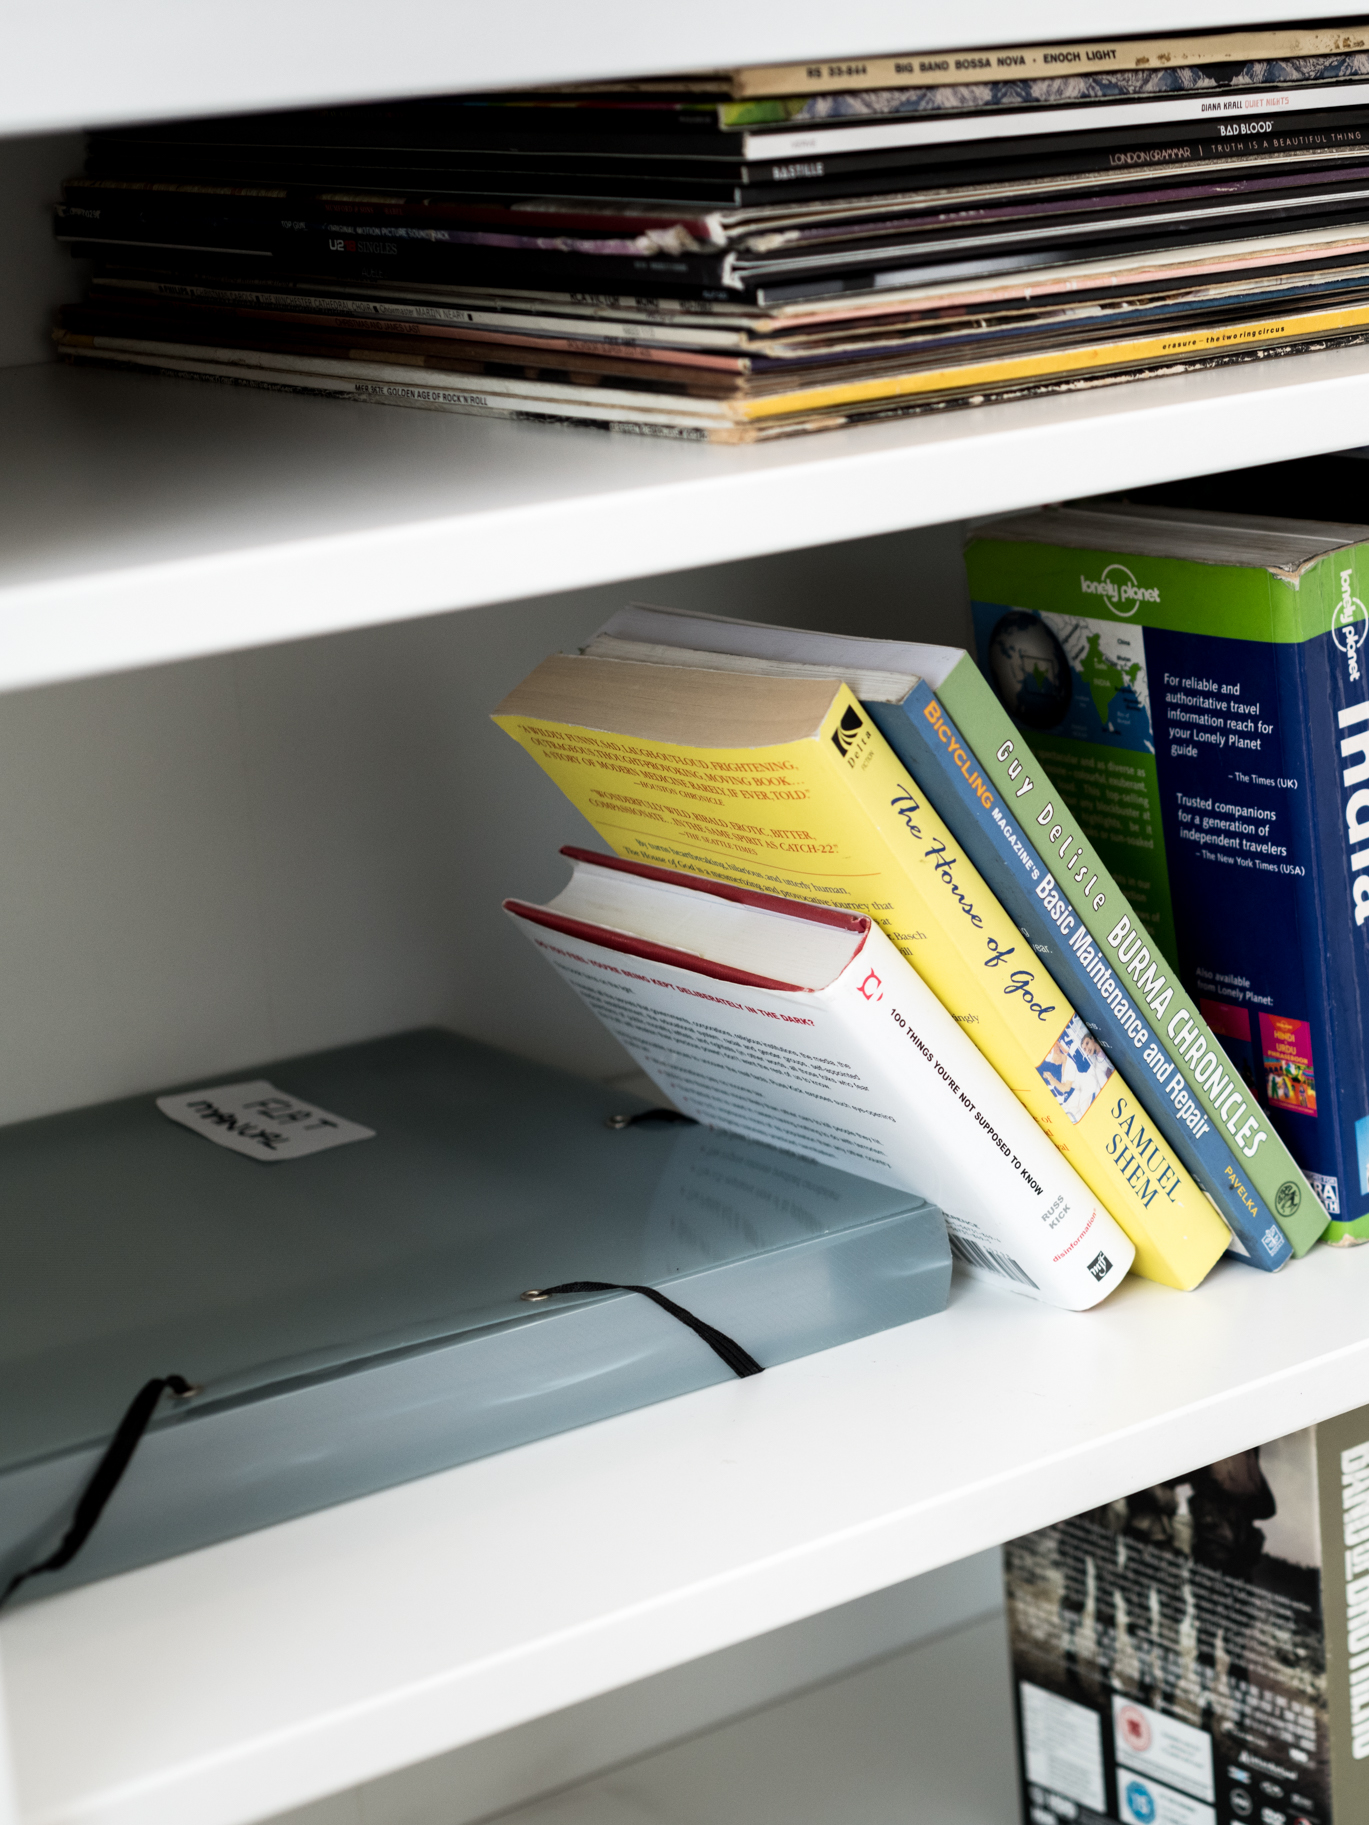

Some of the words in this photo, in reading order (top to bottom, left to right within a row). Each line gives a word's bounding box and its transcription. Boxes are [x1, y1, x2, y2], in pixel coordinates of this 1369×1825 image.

[895, 62, 914, 74] BIG
[919, 59, 950, 72] BAND
[955, 57, 991, 71] BOSSA
[997, 55, 1026, 68] NOVA
[1043, 51, 1082, 64] ENOCH
[1086, 49, 1118, 62] LIGHT
[1201, 101, 1222, 112] DIANA
[1223, 100, 1243, 111] KRALL
[1245, 98, 1264, 109] QUIET
[1265, 96, 1290, 108] NIGHTS
[1109, 152, 1149, 165] LONDON
[1150, 147, 1191, 162] GRAMMAR
[1211, 142, 1244, 153] TRUTH
[1249, 141, 1258, 150] IS
[1263, 140, 1269, 148] A
[1273, 134, 1328, 147] BEAUTIFUL
[1331, 131, 1363, 142] THING
[772, 162, 825, 181] BASTILLE
[381, 227, 409, 239] PICTURE
[329, 239, 345, 252] U2
[357, 240, 398, 256] SINGLES
[1162, 340, 1197, 350] erasure
[1206, 336, 1220, 344] the
[1222, 332, 1238, 341] two
[1239, 329, 1257, 338] ring
[1258, 326, 1286, 336] circus
[387, 387, 416, 399] GOLDEN
[417, 391, 431, 400] AGE
[432, 392, 441, 401] OF
[1080, 575, 1119, 601] lonely
[1120, 584, 1161, 603] planet
[1339, 568, 1354, 625] lonely
[1342, 626, 1360, 682] planet
[1164, 673, 1179, 686] For
[1182, 676, 1218, 692] reliable
[1221, 683, 1240, 695] and
[1165, 692, 1227, 711] authoritative
[1230, 700, 1260, 715] travel
[1167, 708, 1224, 727] information
[1227, 719, 1255, 732] reach
[1258, 720, 1274, 734] for
[847, 730, 872, 770] Delta
[1169, 727, 1191, 739] your
[1193, 729, 1226, 748] Lonely
[1228, 734, 1261, 750] Planet
[1170, 744, 1198, 757] guide
[705, 772, 751, 786] MOVING
[1234, 772, 1250, 783] The
[1251, 774, 1275, 787] Times
[1277, 778, 1298, 789] (UK)
[1176, 792, 1212, 810] Trusted
[1214, 802, 1276, 821] companions
[1178, 809, 1192, 823] for
[1194, 815, 1200, 824] a
[1202, 817, 1255, 834] generation
[1258, 824, 1270, 836] of
[765, 840, 778, 850] AS
[1180, 826, 1240, 849] independent
[1242, 838, 1287, 857] travelers
[1201, 849, 1216, 861] The
[1217, 852, 1234, 864] New
[1236, 856, 1254, 868] York
[1255, 859, 1279, 872] Times
[1280, 864, 1306, 876] (USA)
[811, 881, 851, 896] human,
[871, 901, 894, 910] that
[890, 783, 923, 840] The
[924, 837, 984, 930] House
[984, 936, 1016, 967] of
[1004, 970, 1056, 1023] God
[895, 931, 928, 941] Basch
[922, 699, 995, 809] BICYCLING
[990, 807, 1041, 880] MAGAZINE'S
[1035, 873, 1076, 936] Basic
[1068, 925, 1149, 1048] Maintenance
[1142, 1043, 1172, 1084] and
[1164, 1074, 1210, 1140] Repair
[1223, 1164, 1259, 1218] PAVELKA
[1215, 973, 1250, 988] available
[675, 985, 744, 1011] DELIBERATELY
[745, 1005, 758, 1015] IN
[757, 1008, 781, 1020] THE
[779, 1013, 816, 1027] DARK?
[1217, 985, 1244, 1001] Lonely
[1245, 991, 1274, 1006] Planet:
[1106, 913, 1175, 1022] BURMA
[1166, 1008, 1268, 1159] CHRONICLES
[1274, 1030, 1296, 1043] HINDI
[1276, 1043, 1297, 1055] URDU
[889, 1008, 907, 1029] 100
[905, 1026, 934, 1062] THINGS
[933, 1059, 960, 1095] YOU'RE
[958, 1088, 977, 1113] NOT
[974, 1110, 1012, 1158] SUPPOSED
[1010, 1154, 1023, 1171] TO
[1020, 1168, 1045, 1196] KNOW
[1110, 1097, 1183, 1203] SAMUEL
[1105, 1133, 1160, 1210] SHEM
[1040, 1193, 1065, 1223] RUSS
[1048, 1204, 1072, 1230] KICK
[1052, 1210, 1096, 1263] disinformation
